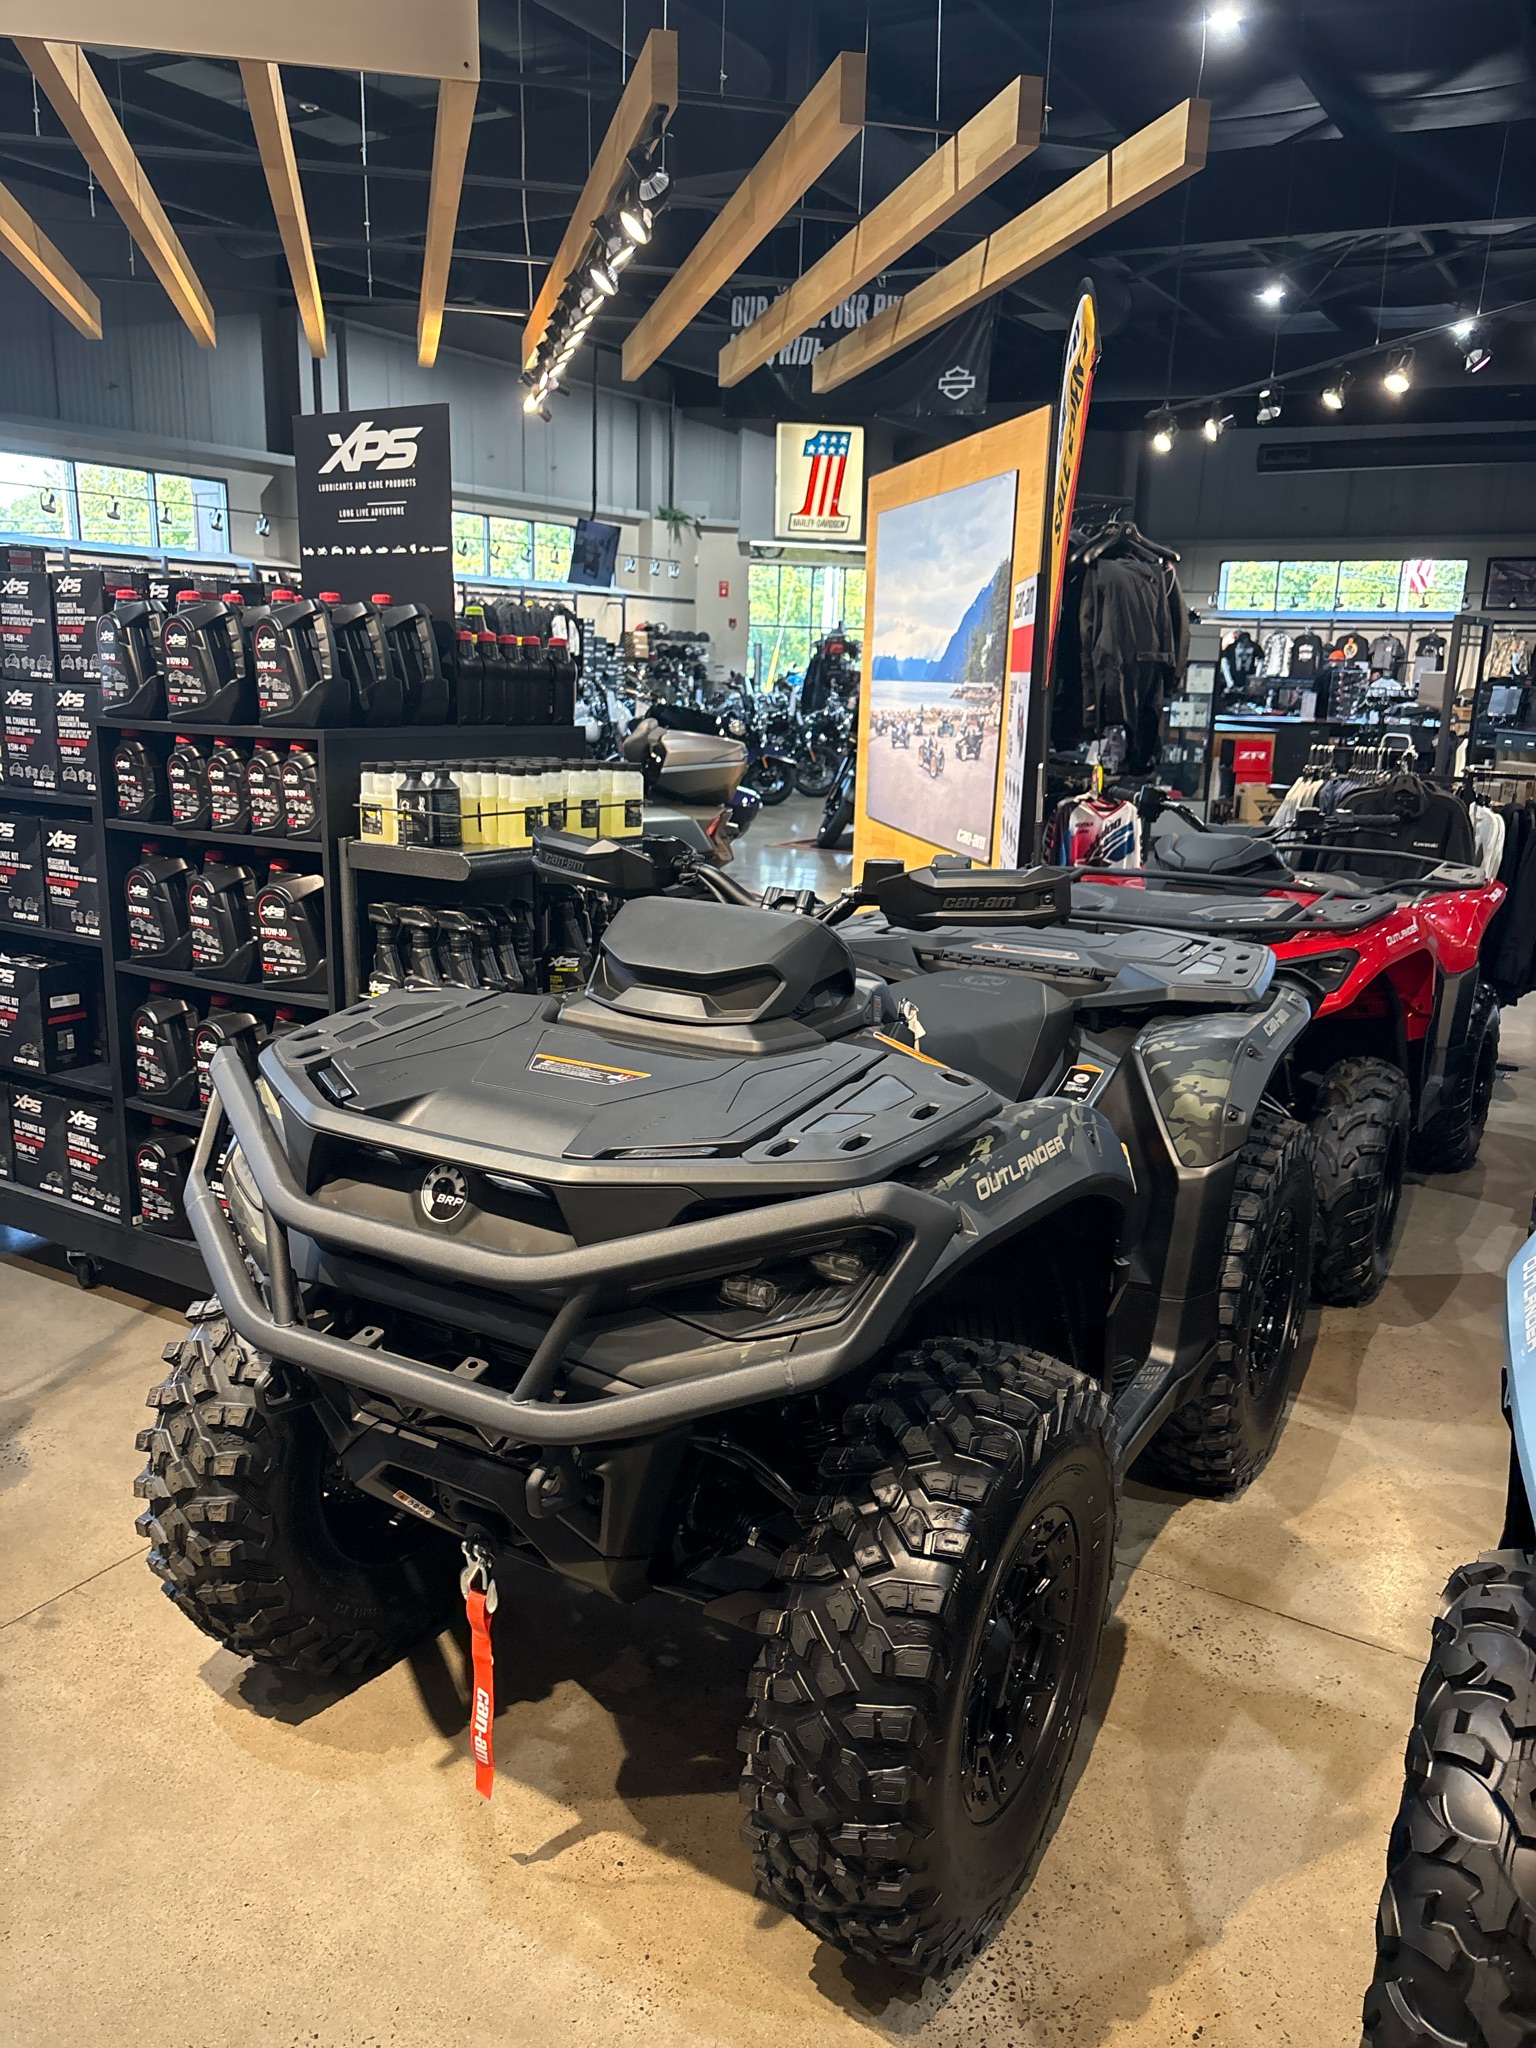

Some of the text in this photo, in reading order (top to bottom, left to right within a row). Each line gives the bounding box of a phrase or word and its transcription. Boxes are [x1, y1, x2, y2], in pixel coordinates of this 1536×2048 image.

[831, 294, 869, 328] OUR
[318, 421, 424, 474] XPS
[318, 478, 416, 492] LUBRICANTS AND CARE PRODUCTS
[339, 506, 405, 518] LONG LIVE ADVENTURE
[0, 578, 29, 595] XPS
[56, 576, 82, 593] XPS
[100, 630, 114, 642] XPS
[166, 633, 187, 645] XPS
[257, 636, 276, 649] XPS
[5, 689, 33, 706] XPS
[56, 690, 85, 707] XPS
[116, 760, 130, 769] XPS
[170, 767, 184, 777] XPS
[209, 770, 224, 780] XPS
[249, 772, 264, 782] XPS
[283, 774, 298, 784] XPS
[46, 830, 77, 849] XPS
[957, 829, 986, 850] can-am
[545, 852, 584, 871] can-am
[129, 884, 148, 896] XPS
[191, 894, 208, 907] XPS
[942, 896, 1016, 909] can-am
[13, 911, 39, 921] can-am
[261, 905, 285, 917] XPS
[75, 925, 100, 936] can-am
[549, 955, 580, 967] XPS
[1263, 1008, 1290, 1037] can-am
[137, 1026, 153, 1038] XPS
[198, 1040, 217, 1051] XPS
[13, 1094, 43, 1113] XPS
[67, 1110, 98, 1130] XPS
[138, 1159, 158, 1172] XPS
[976, 1135, 1065, 1201] OUTLANDER
[436, 1193, 464, 1206] BRP
[475, 1687, 490, 1765] can-am
